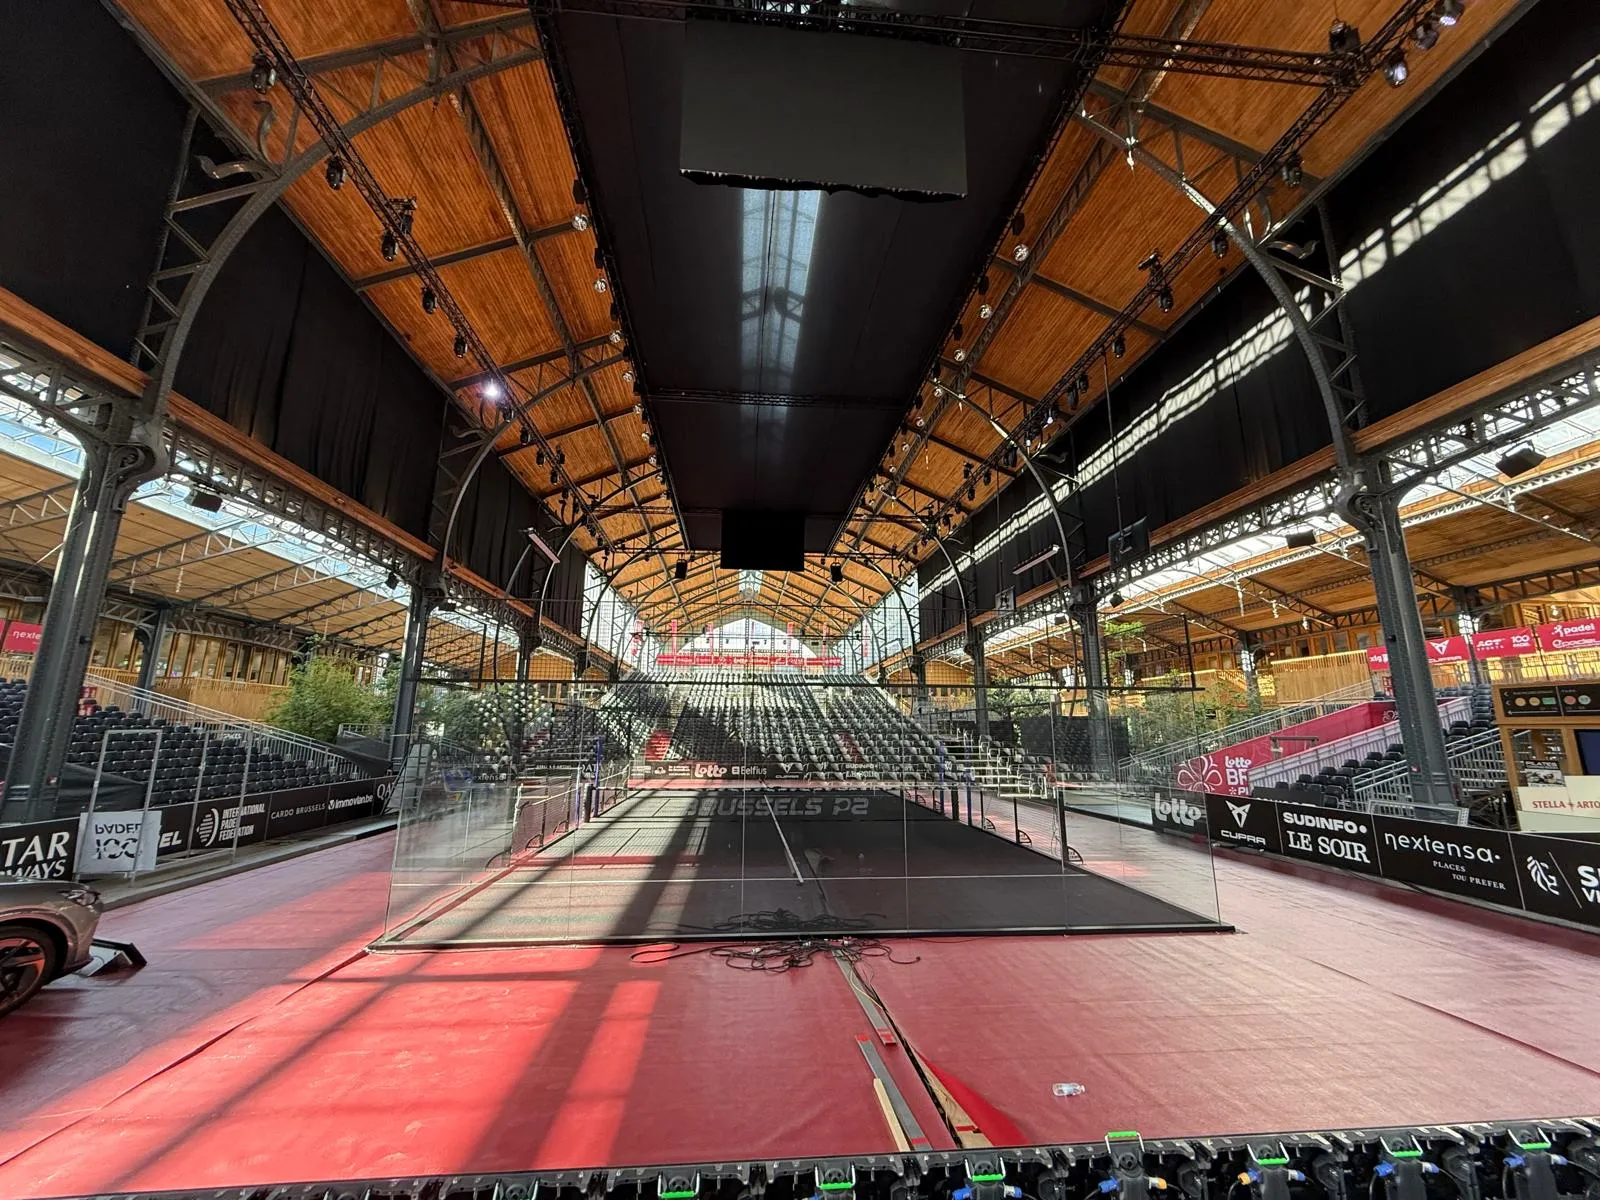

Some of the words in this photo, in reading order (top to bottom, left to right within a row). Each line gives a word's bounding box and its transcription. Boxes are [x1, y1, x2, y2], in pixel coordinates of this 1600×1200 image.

[1224, 755, 1252, 768] lotto
[694, 763, 727, 778] lotto
[270, 810, 294, 819] CARDO
[296, 803, 326, 815] BRUSSELS
[1154, 792, 1202, 827] lotto
[1532, 800, 1567, 809] STELLA
[1221, 829, 1267, 846] CUPRA
[1286, 830, 1313, 852] LE
[1317, 836, 1371, 864] SOIR
[1432, 860, 1467, 873] PLACES
[1451, 872, 1468, 882] YOU
[1469, 876, 1507, 891] PREFER
